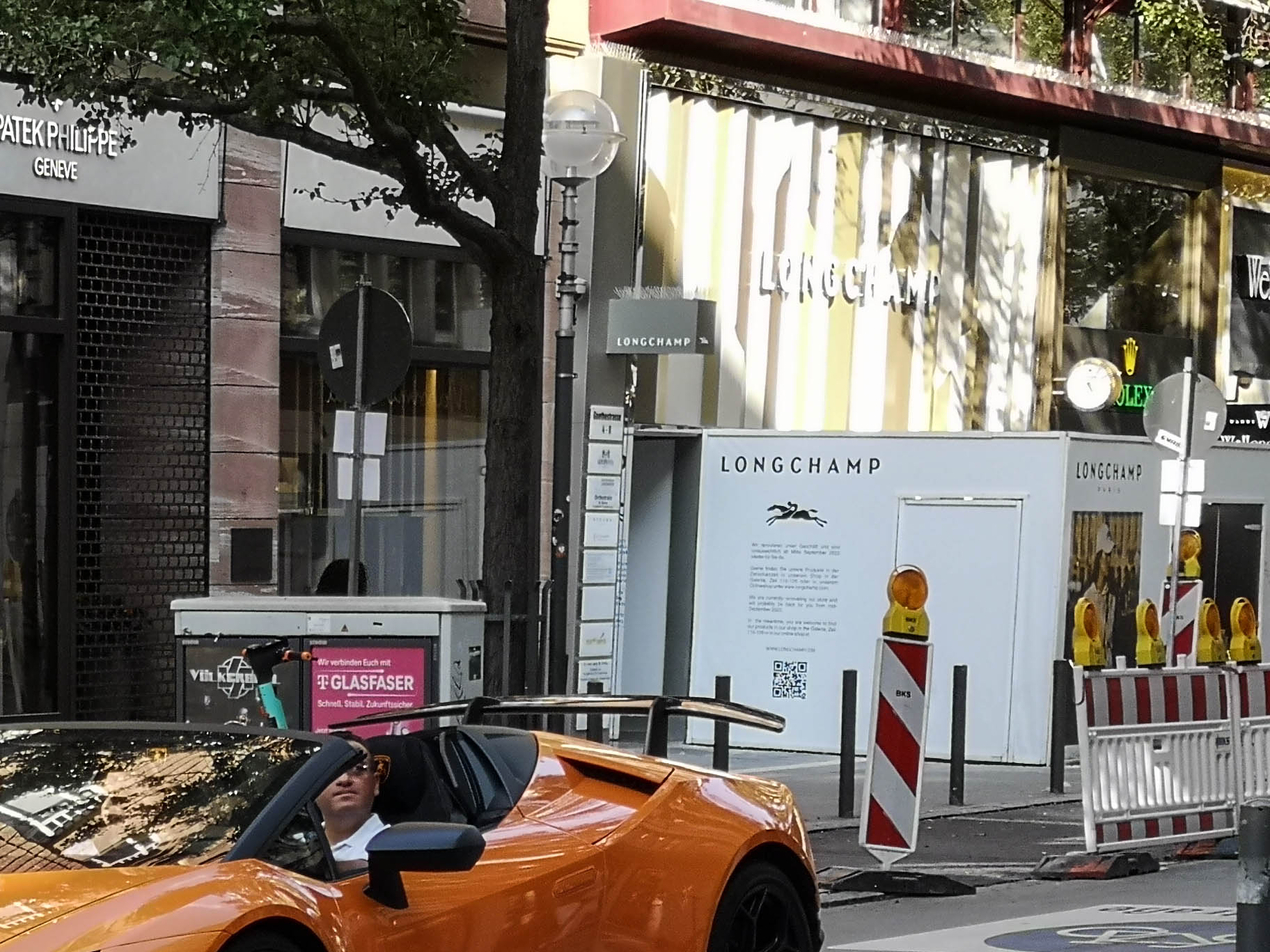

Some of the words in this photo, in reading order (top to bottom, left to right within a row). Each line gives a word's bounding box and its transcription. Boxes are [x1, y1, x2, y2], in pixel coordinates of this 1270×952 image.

[47, 121, 117, 156] PHILIPPE
[34, 156, 78, 180] GENEVE
[759, 251, 940, 308] LONGCHAMP
[616, 337, 691, 347] LONGCHAMP
[721, 456, 881, 474] LONGCHAMP
[1076, 461, 1142, 481] LONGCHAMP
[318, 658, 329, 666] Wir
[331, 675, 414, 691] GLASFASER
[896, 690, 911, 698] BKS
[317, 699, 343, 708] Schnell.
[344, 700, 365, 708] Stabil.
